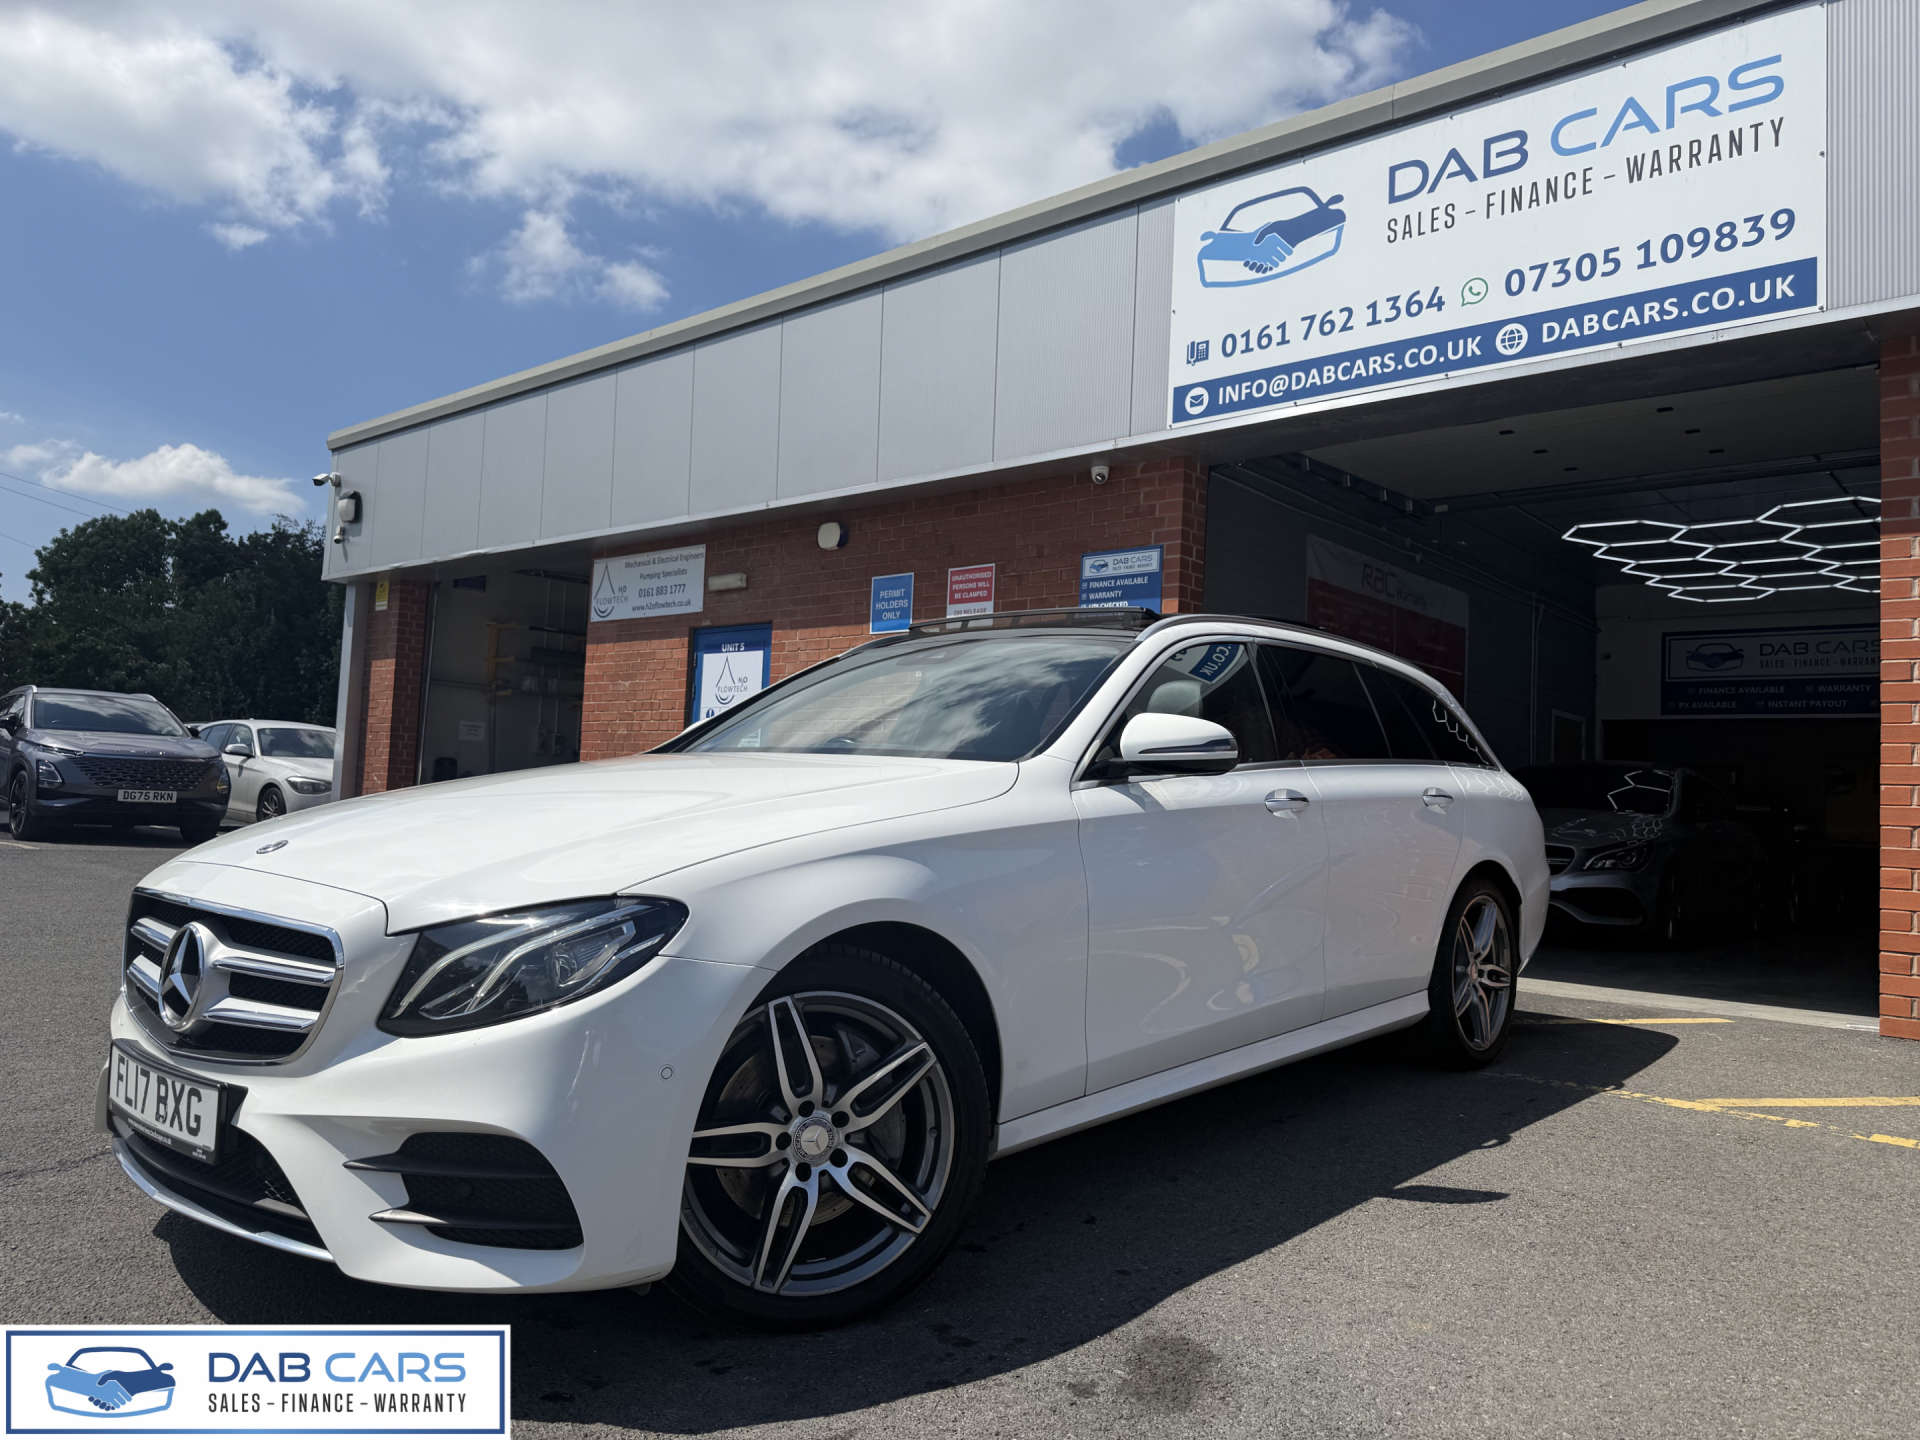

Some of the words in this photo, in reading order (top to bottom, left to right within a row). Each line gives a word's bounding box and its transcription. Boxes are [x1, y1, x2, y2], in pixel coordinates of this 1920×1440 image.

[1388, 130, 1529, 205] DAB
[1550, 54, 1785, 158] CARS
[1386, 202, 1457, 245] SALES
[1485, 166, 1594, 220] FINANCE
[1625, 116, 1786, 185] WARRANTY
[1221, 319, 1291, 359] 0161
[1300, 306, 1355, 343] 762
[1365, 286, 1446, 327] 1364
[1504, 245, 1622, 298] 07305
[1636, 207, 1797, 273] 109839
[1217, 333, 1483, 406] INFO@DABCARS.CO.UK
[1541, 273, 1797, 344] DABCARS.CO.UK
[1112, 557, 1129, 566] DAB
[1130, 554, 1153, 564] CARS
[640, 571, 661, 580] Pumping
[662, 568, 688, 578] Specialists
[1089, 580, 1115, 589] FINANCE
[1116, 576, 1149, 586] AVAILABLE
[638, 587, 655, 598] 0161
[669, 583, 686, 594] 1777
[879, 588, 905, 598] PERMIT
[1088, 590, 1122, 600] WARRANTY
[875, 599, 909, 610] HOLDERS
[882, 610, 901, 620] ONLY
[721, 643, 739, 652] UNIT
[1759, 641, 1809, 656] DAB
[717, 685, 749, 694] FLOWTECH
[1738, 685, 1785, 694] AVAILABLE
[1817, 684, 1872, 693] WARRANTY
[122, 791, 151, 801] DG75
[153, 792, 174, 802] RKN
[116, 1054, 150, 1114] FL17
[155, 1075, 203, 1137] BXG
